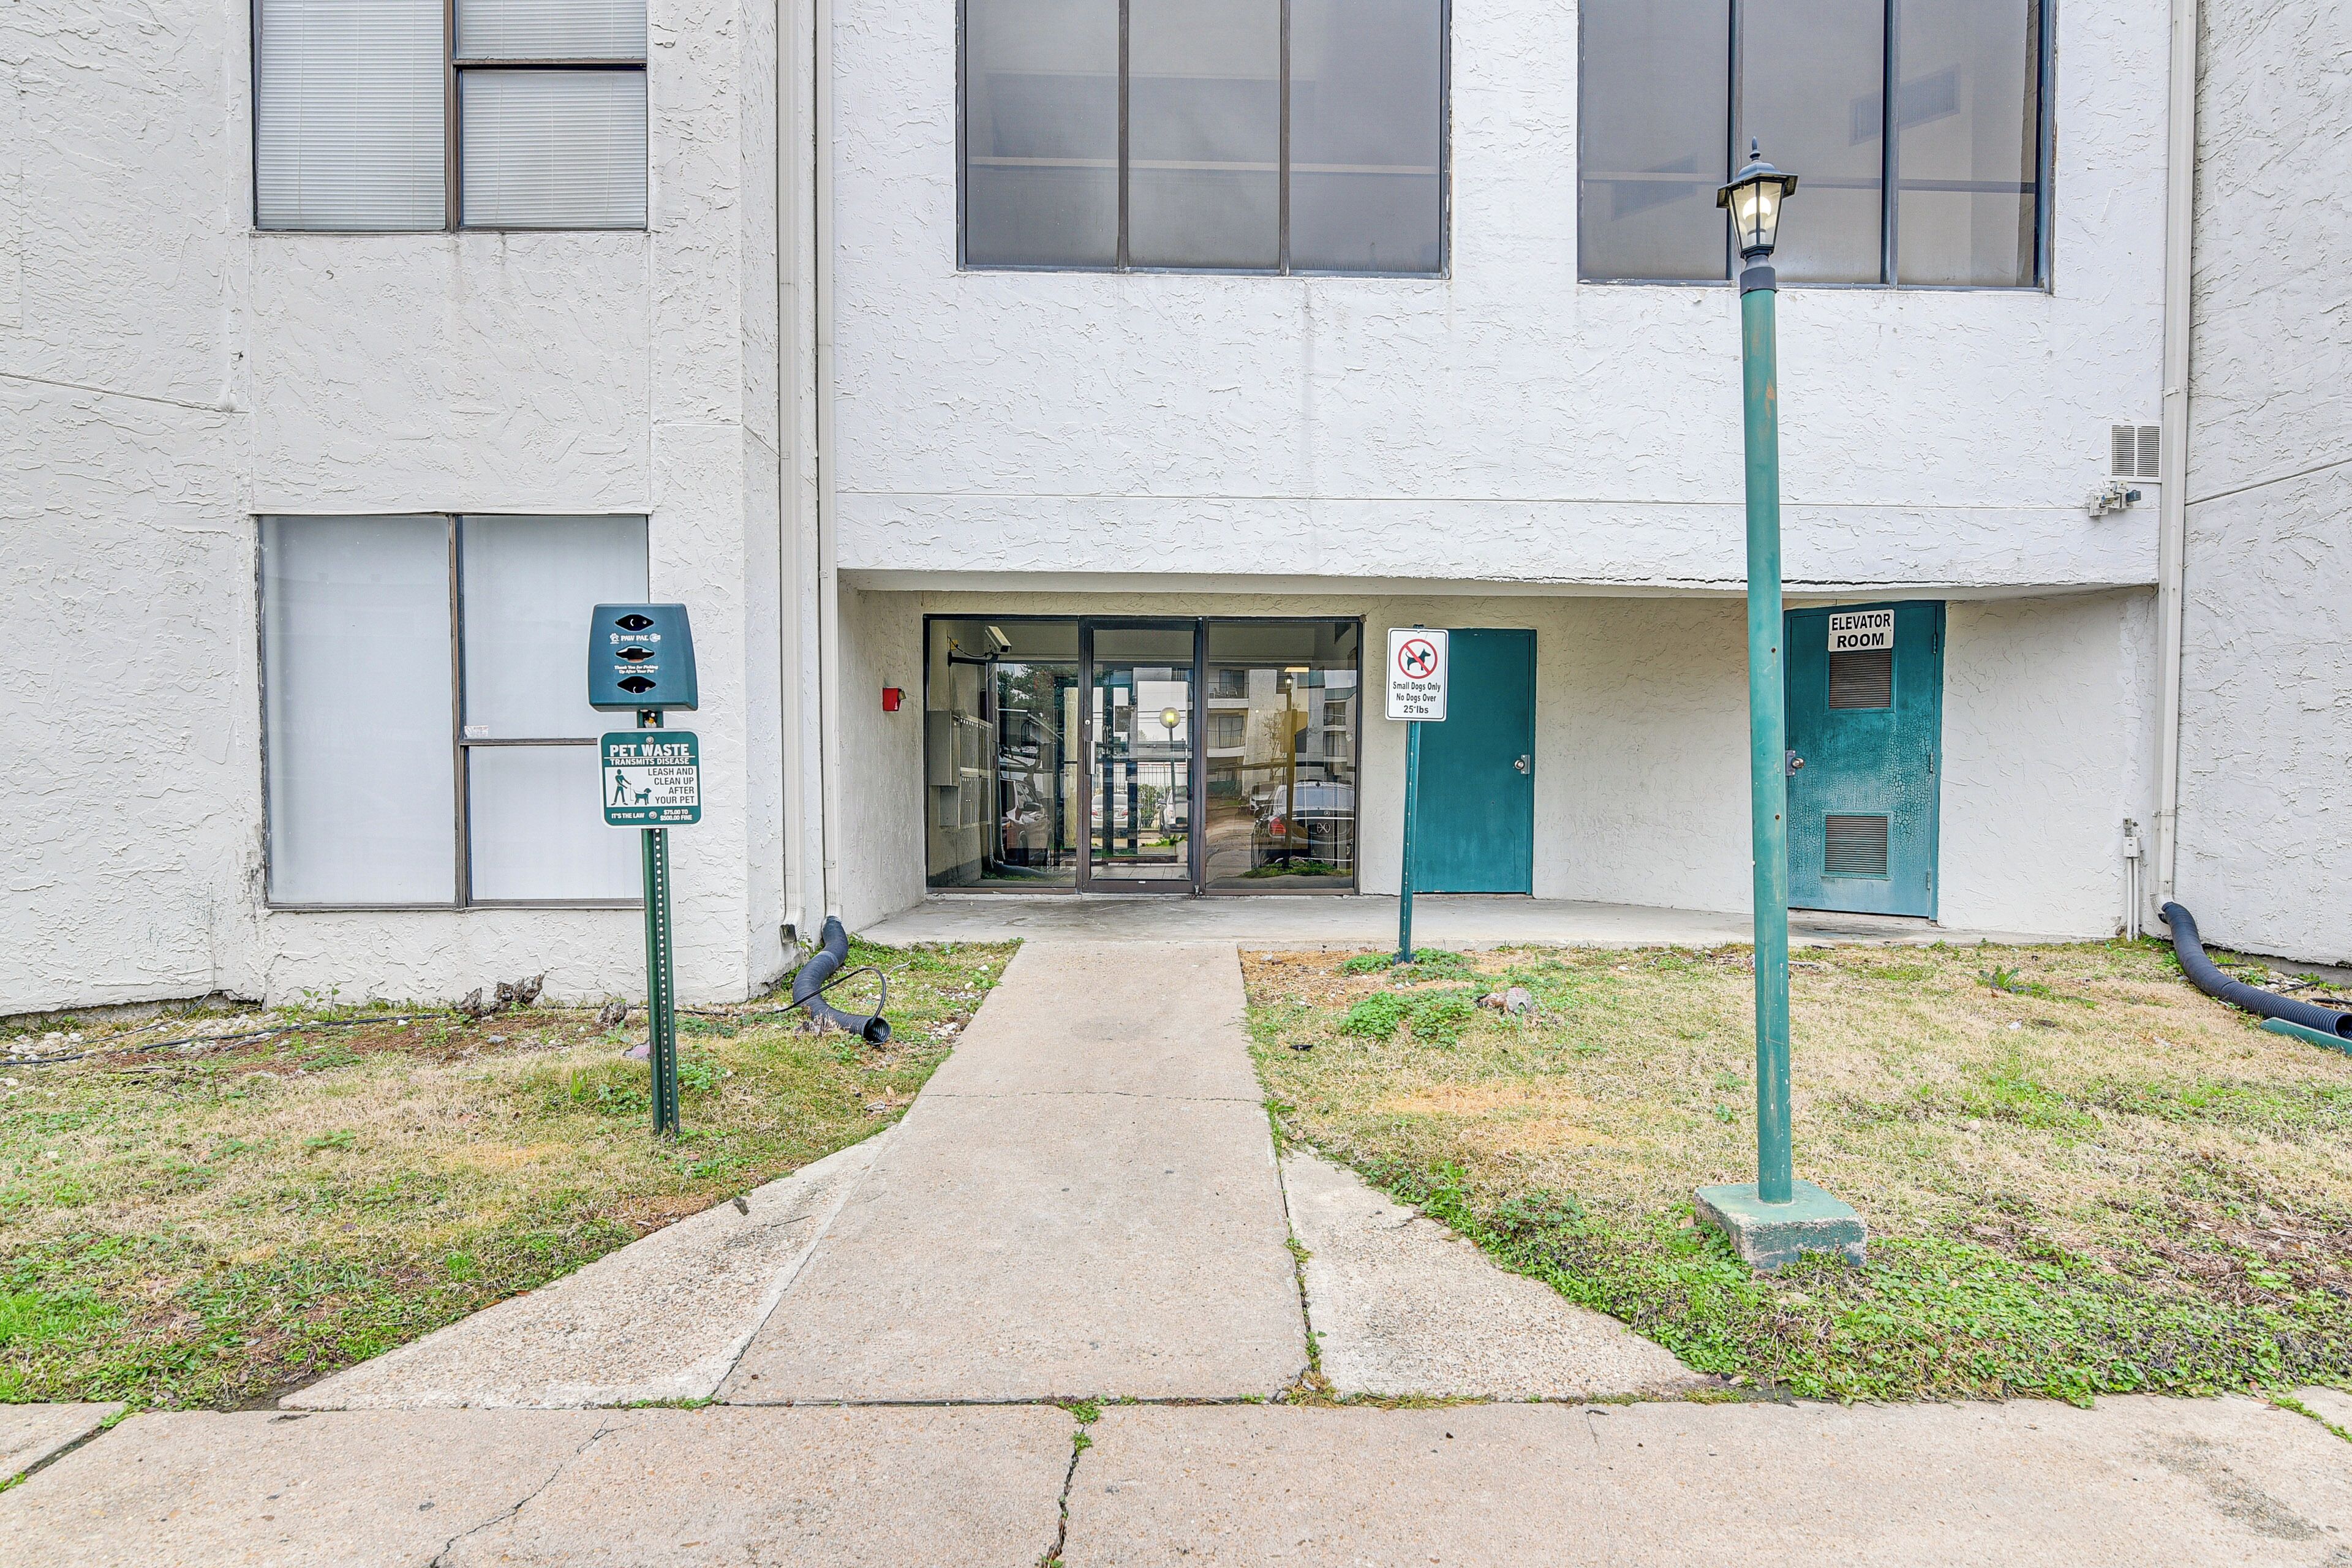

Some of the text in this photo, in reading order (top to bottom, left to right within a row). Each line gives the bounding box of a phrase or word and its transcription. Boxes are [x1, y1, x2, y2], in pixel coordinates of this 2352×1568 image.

[1832, 613, 1890, 631] ELEVATOR
[1837, 633, 1884, 648] ROOM
[1411, 682, 1425, 692] Dogs
[1427, 682, 1441, 692] Only
[1406, 693, 1420, 703] Dogs
[1422, 693, 1436, 702] Over
[609, 744, 690, 757] PET WASTE
